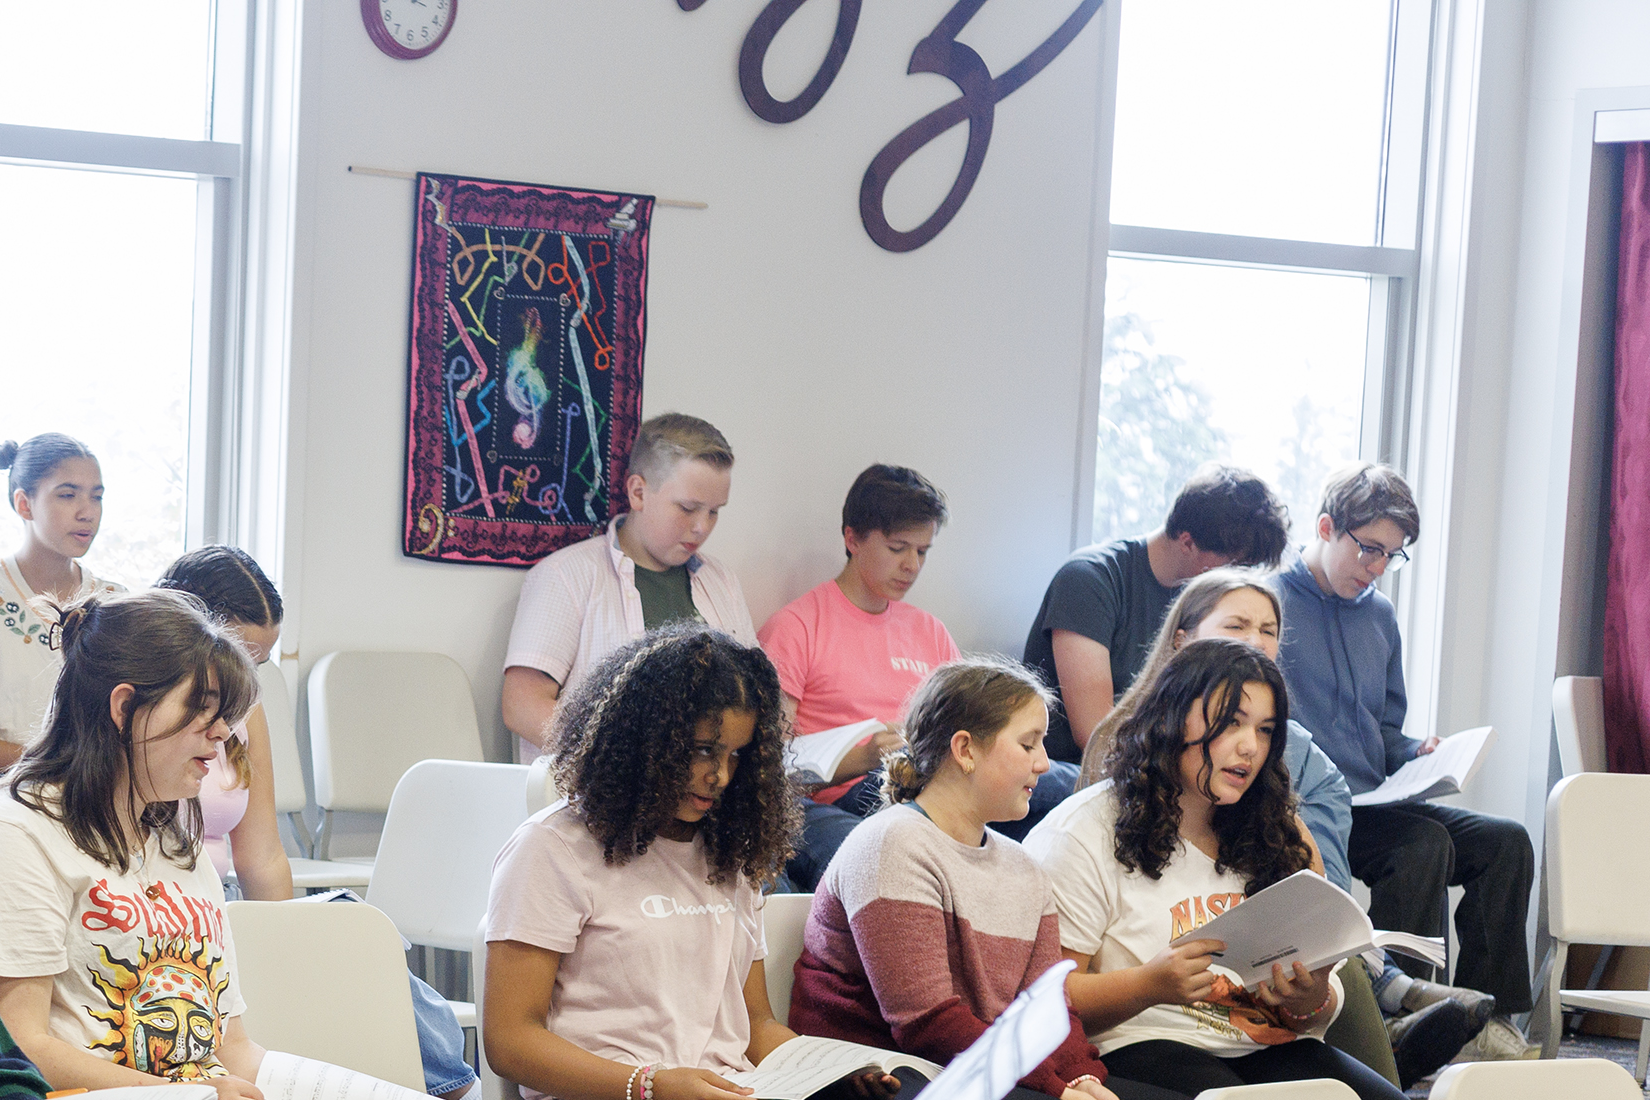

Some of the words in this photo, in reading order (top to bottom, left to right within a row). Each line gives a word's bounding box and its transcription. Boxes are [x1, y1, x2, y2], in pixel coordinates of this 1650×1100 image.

[383, 9, 392, 21] 8
[432, 15, 439, 25] 4
[394, 23, 401, 35] 7
[420, 26, 429, 38] 5
[406, 30, 414, 41] 6
[640, 894, 737, 925] Champi
